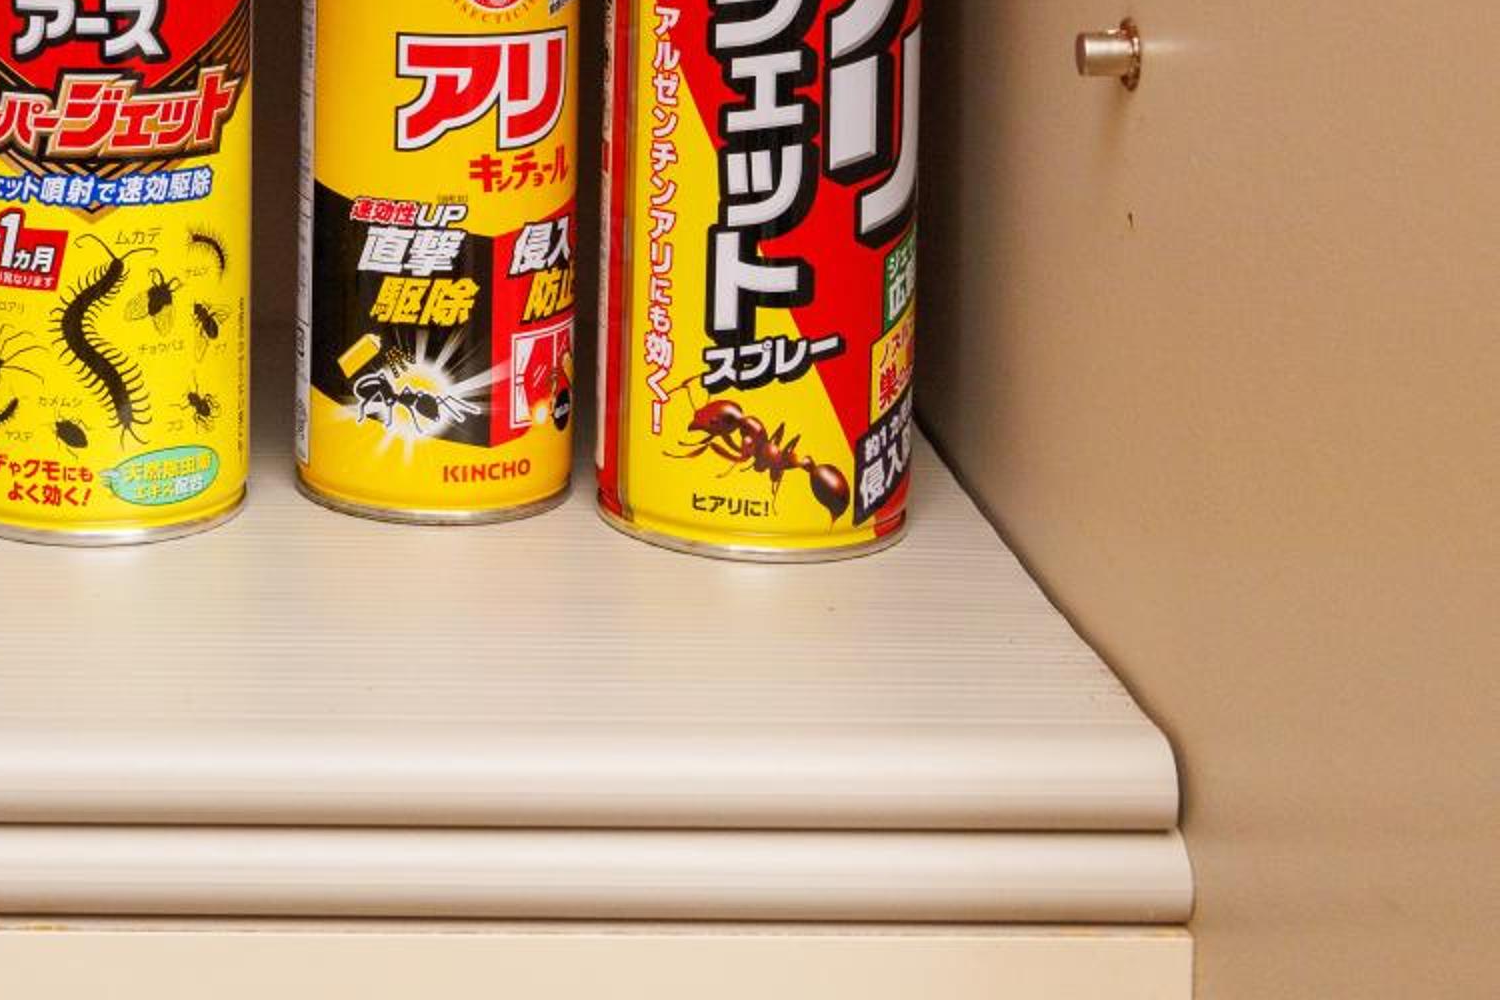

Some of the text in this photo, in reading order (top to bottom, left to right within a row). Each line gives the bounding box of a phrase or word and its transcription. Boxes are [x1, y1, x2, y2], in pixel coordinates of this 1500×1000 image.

[396, 26, 568, 151] アリ
[469, 146, 569, 193] キンチョール
[115, 228, 165, 245] ムカデ
[357, 226, 466, 276] 直撃
[510, 216, 571, 276] 侵入
[370, 277, 479, 326] 駆除
[522, 260, 574, 321] 防止
[702, 335, 839, 386] スプレー
[7, 483, 92, 506] よく効く!
[443, 459, 531, 482] KINCHO
[692, 494, 770, 517] ヒアリに!
